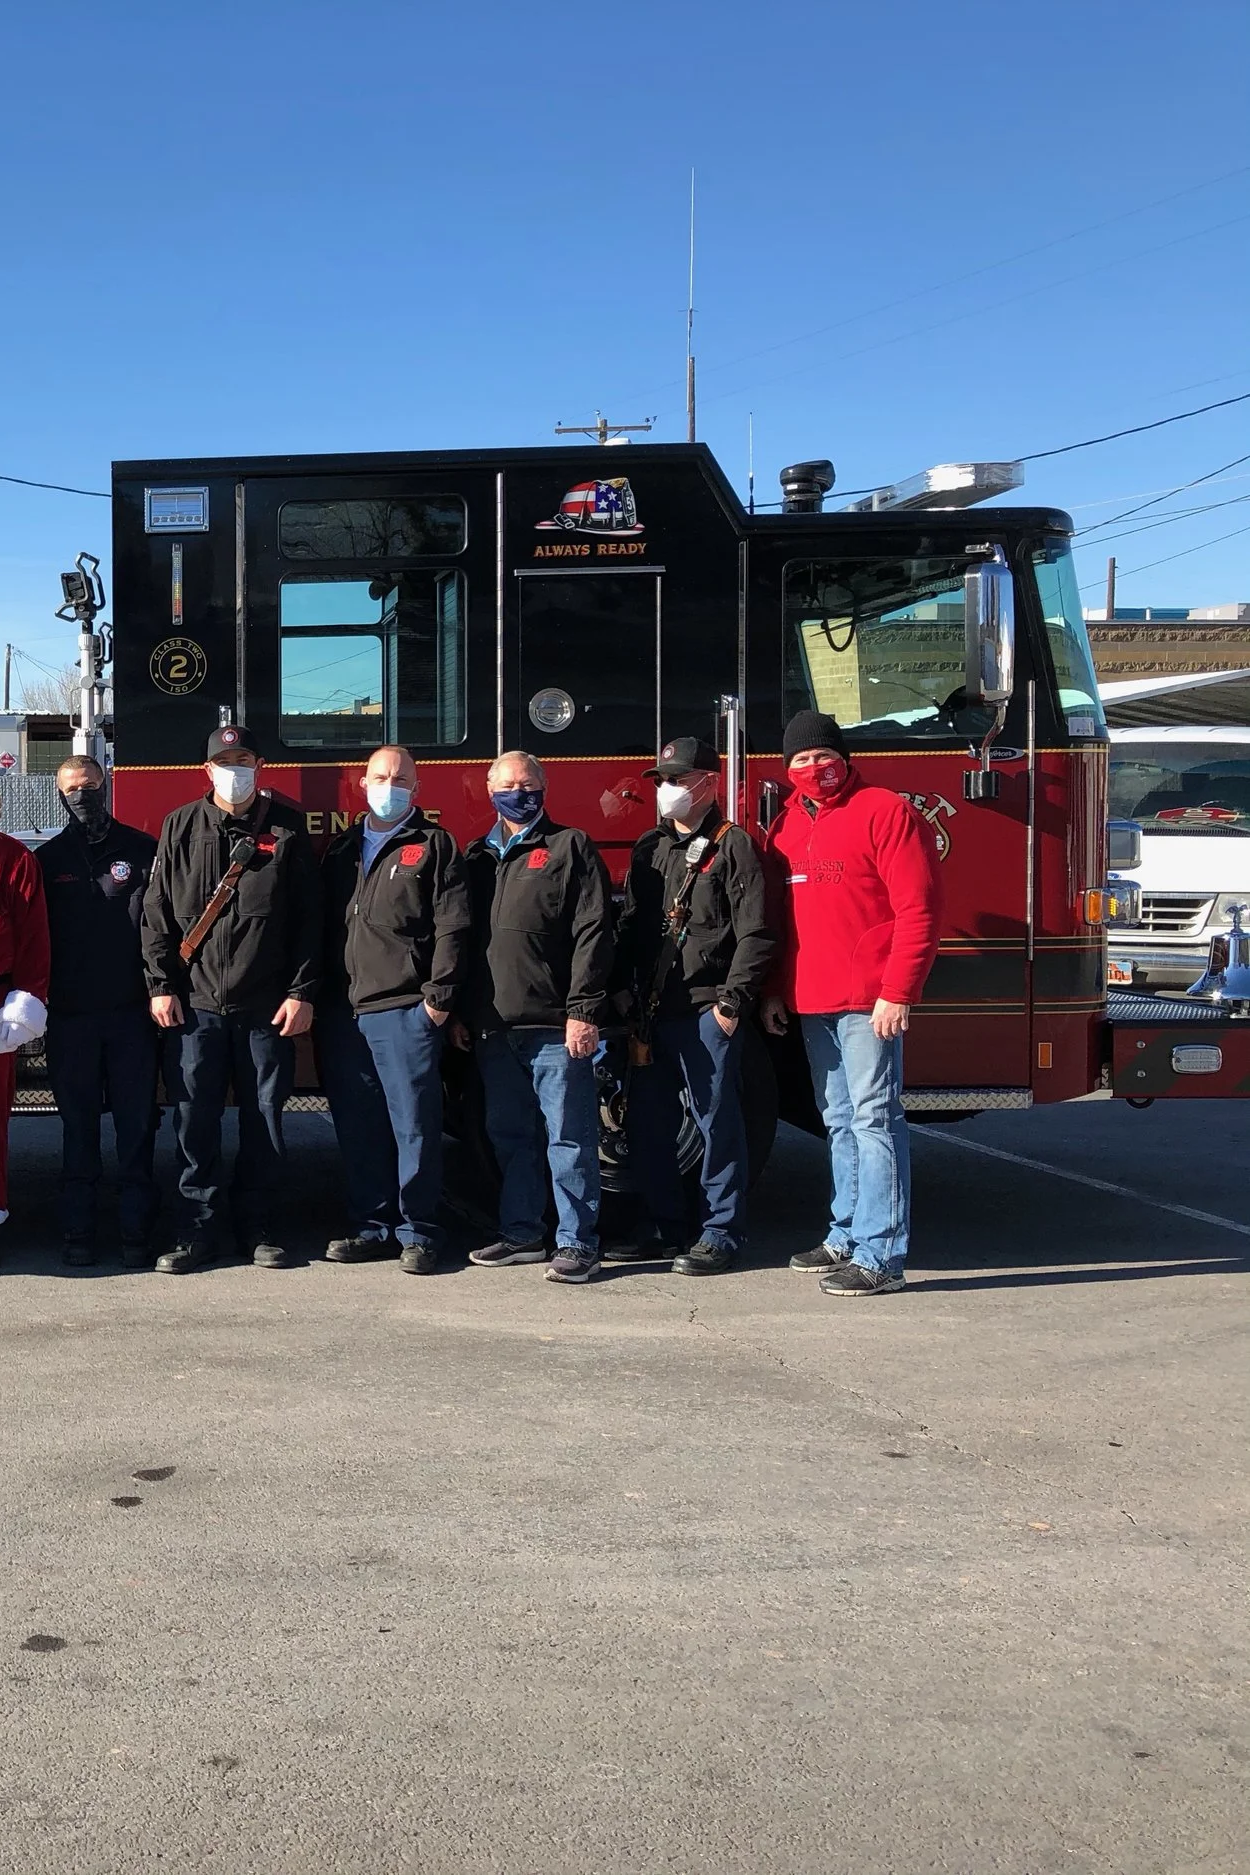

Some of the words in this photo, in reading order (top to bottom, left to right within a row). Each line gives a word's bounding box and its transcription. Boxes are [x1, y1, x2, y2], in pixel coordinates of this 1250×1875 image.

[534, 544, 591, 558] ALWAYS
[597, 543, 647, 557] READY
[154, 640, 182, 660] CLASS
[187, 643, 203, 660] TWO
[170, 655, 188, 678] 2
[170, 685, 189, 693] ISO
